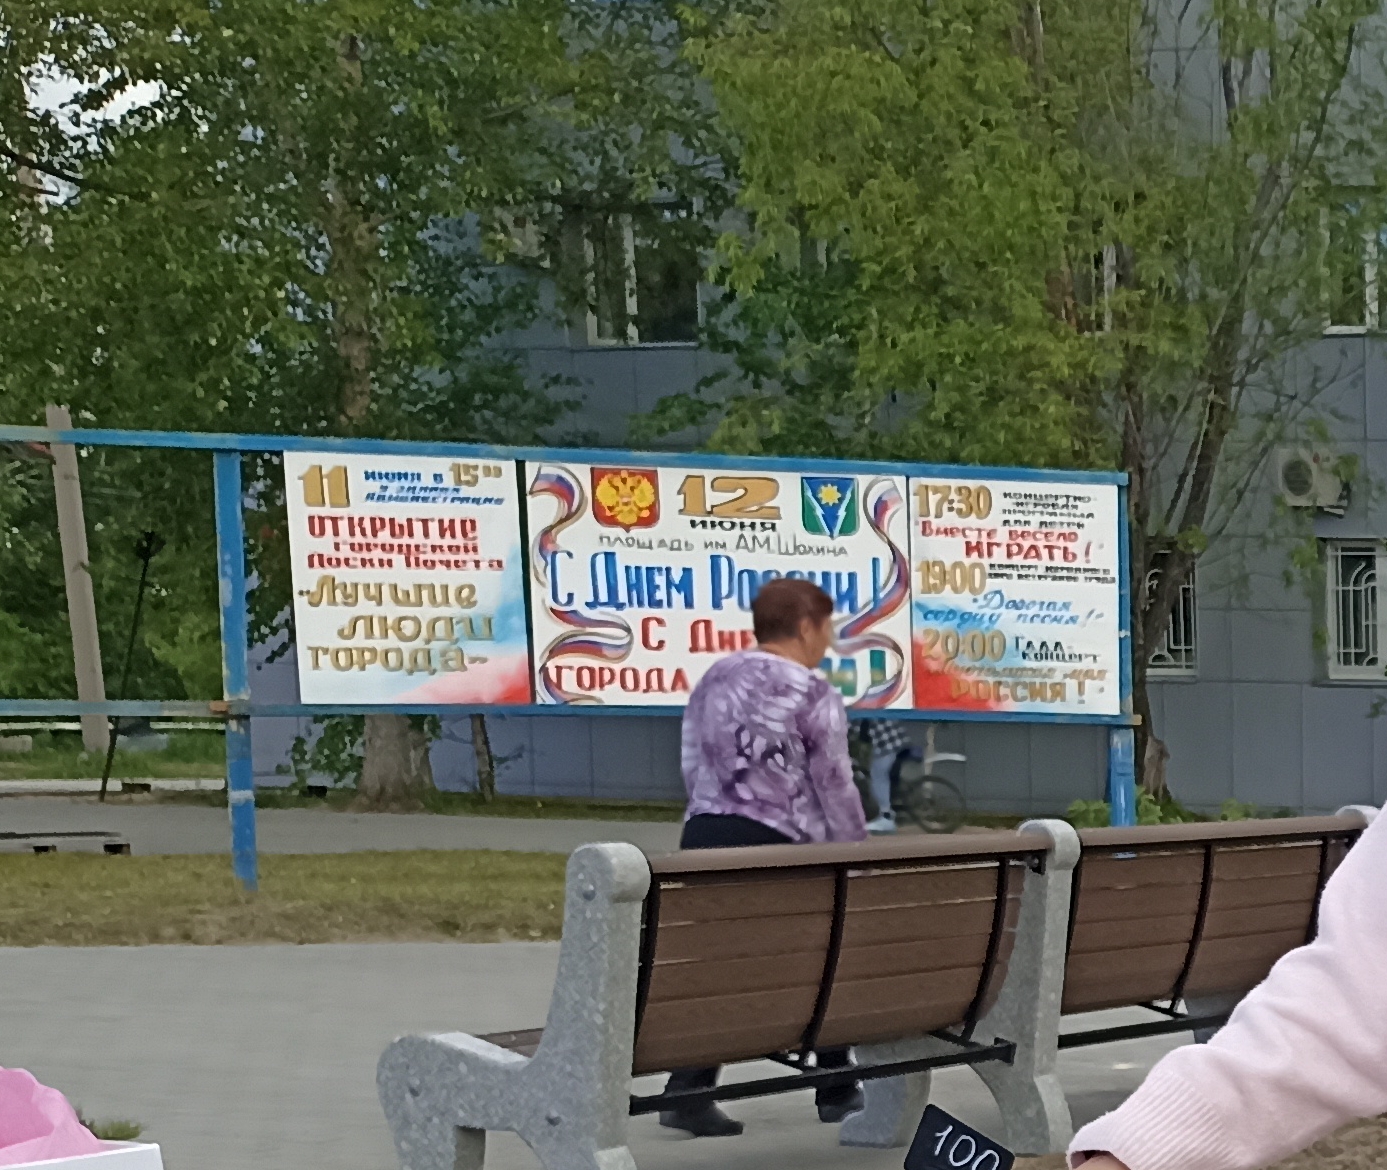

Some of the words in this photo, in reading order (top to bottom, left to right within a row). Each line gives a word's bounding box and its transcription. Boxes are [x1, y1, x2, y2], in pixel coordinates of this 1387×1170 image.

[297, 464, 350, 508] 11
[676, 475, 783, 520] 12
[914, 484, 993, 519] 17:30
[551, 551, 574, 607] С
[641, 617, 666, 651] С
[554, 665, 691, 694] ГОРОДА
